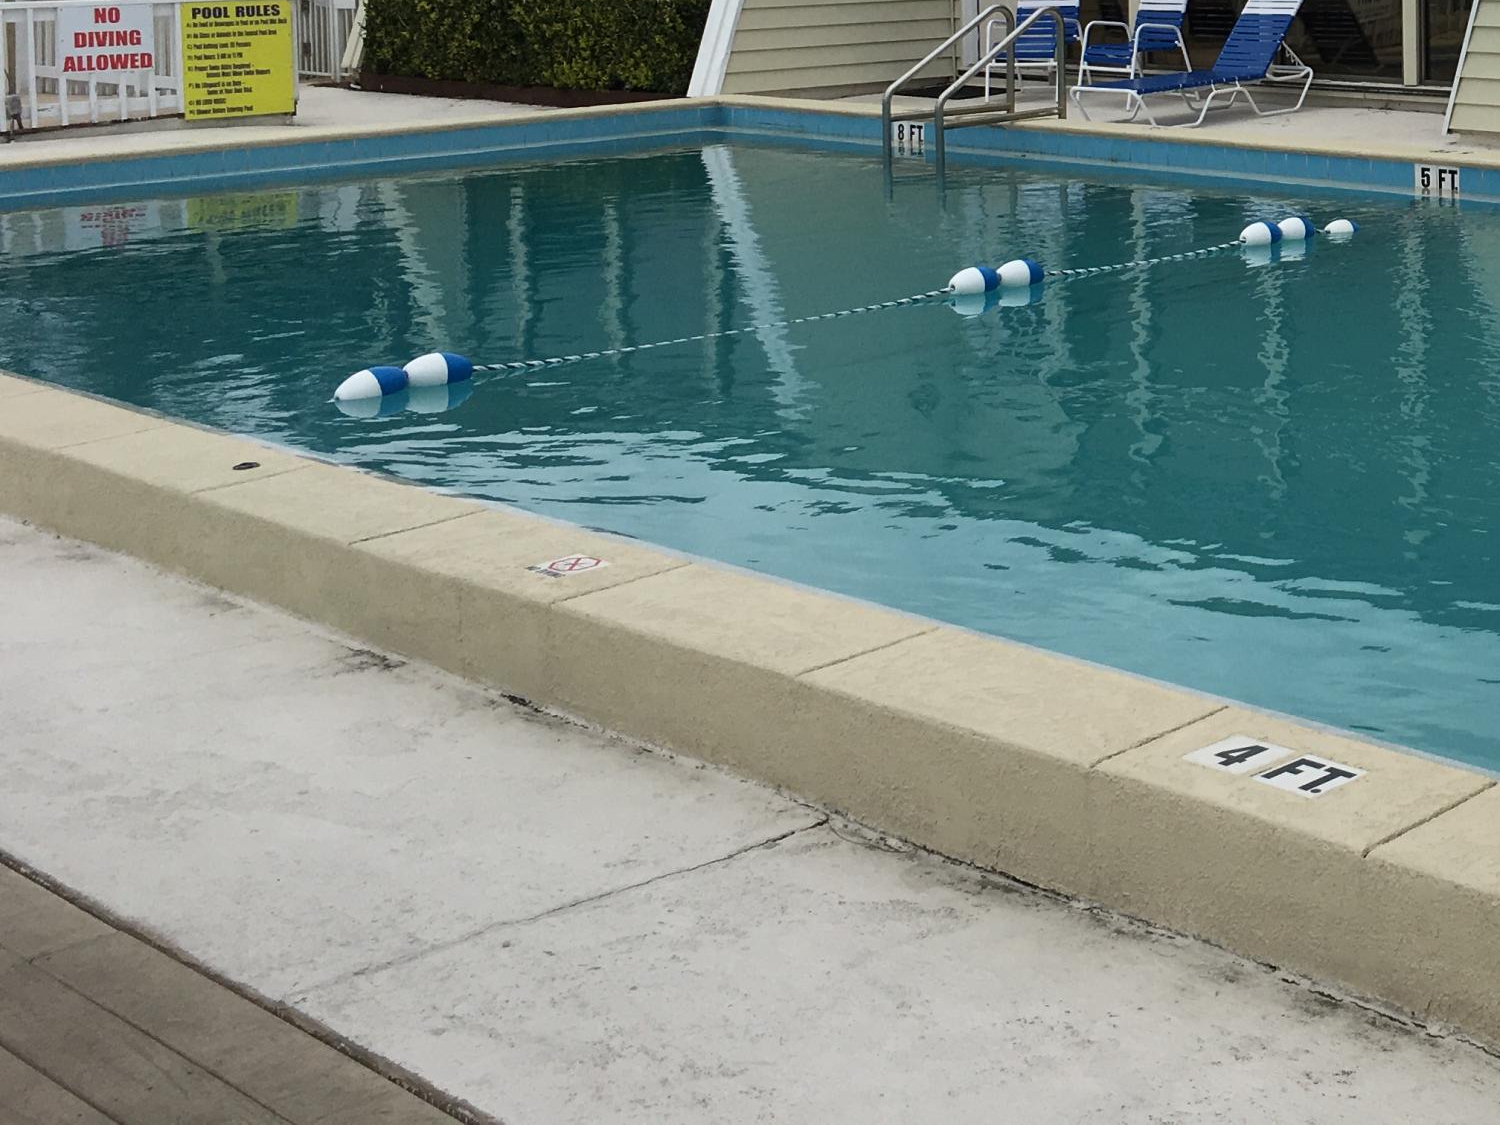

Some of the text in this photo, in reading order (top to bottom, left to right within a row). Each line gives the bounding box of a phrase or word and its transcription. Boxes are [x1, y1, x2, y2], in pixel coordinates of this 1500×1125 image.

[94, 7, 120, 24] NO
[191, 4, 280, 20] POOL RULES
[74, 30, 141, 48] DIVING
[63, 53, 153, 72] ALLOWED
[898, 123, 905, 141] 8
[1421, 167, 1431, 188] 5
[1214, 745, 1358, 794] 4 FT.
